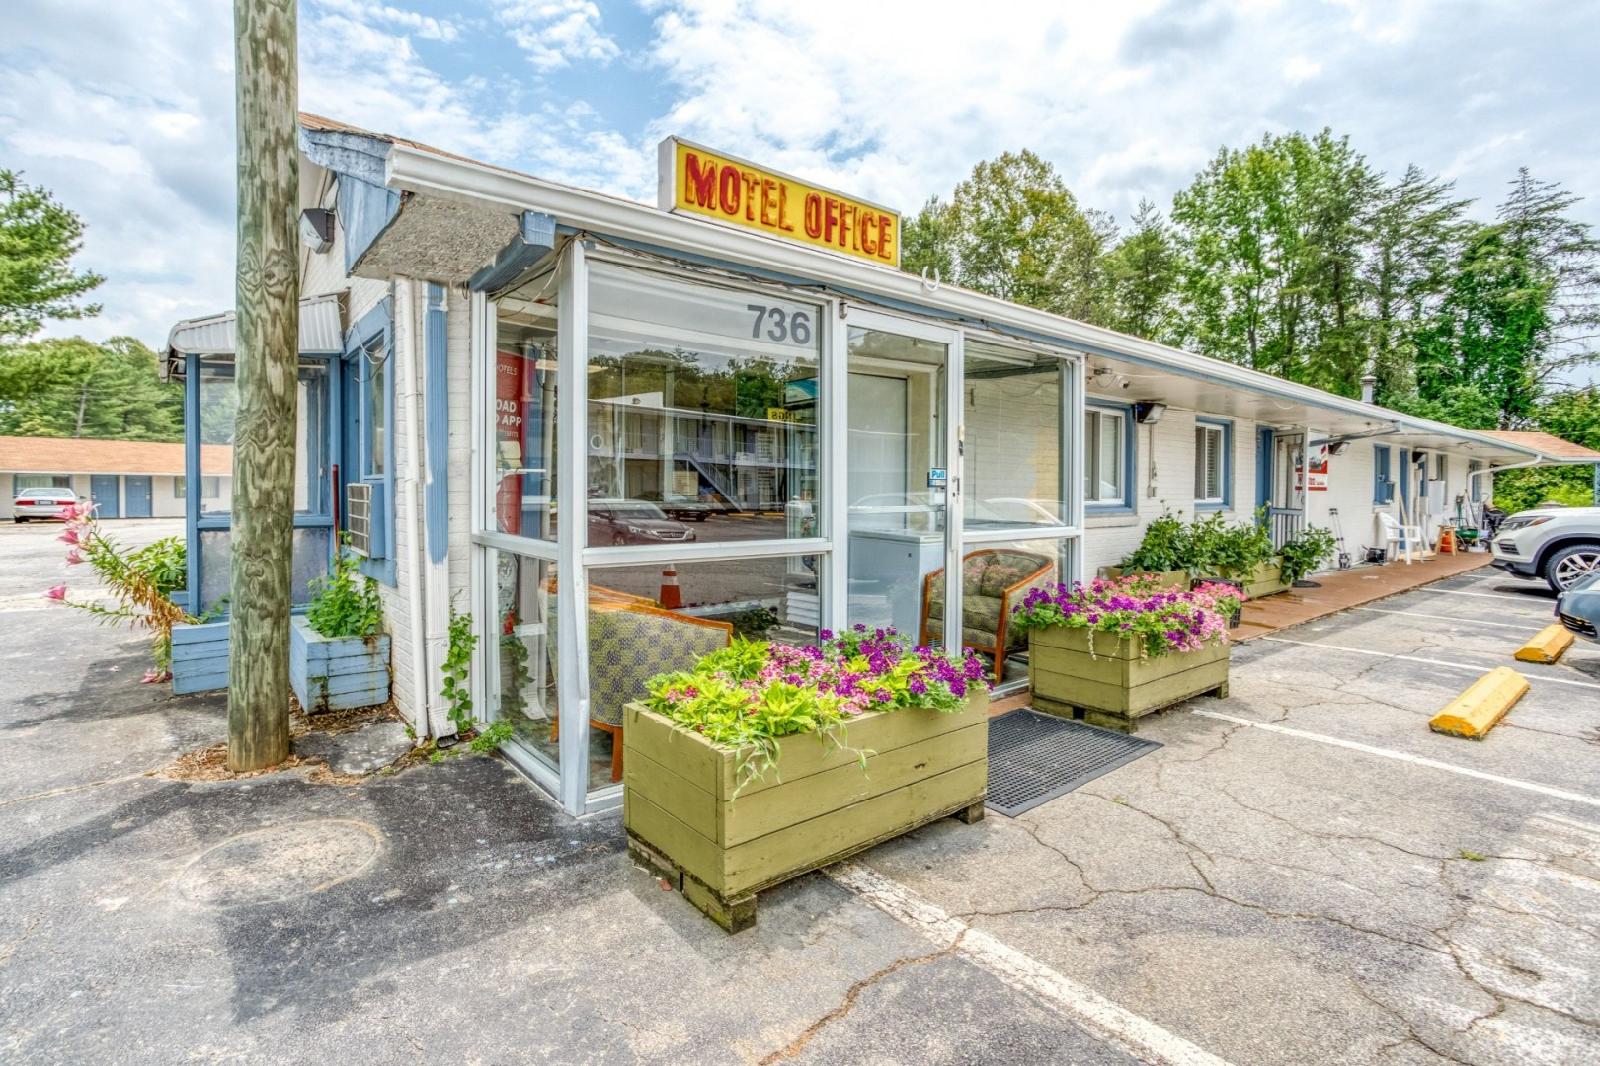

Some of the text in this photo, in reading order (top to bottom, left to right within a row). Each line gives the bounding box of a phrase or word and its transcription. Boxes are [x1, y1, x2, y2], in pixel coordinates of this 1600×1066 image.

[684, 152, 892, 260] MOTEL OFFICE
[747, 304, 811, 345] 736
[497, 364, 518, 375] OTELS
[501, 415, 521, 426] APP
[931, 470, 945, 479] Pull
